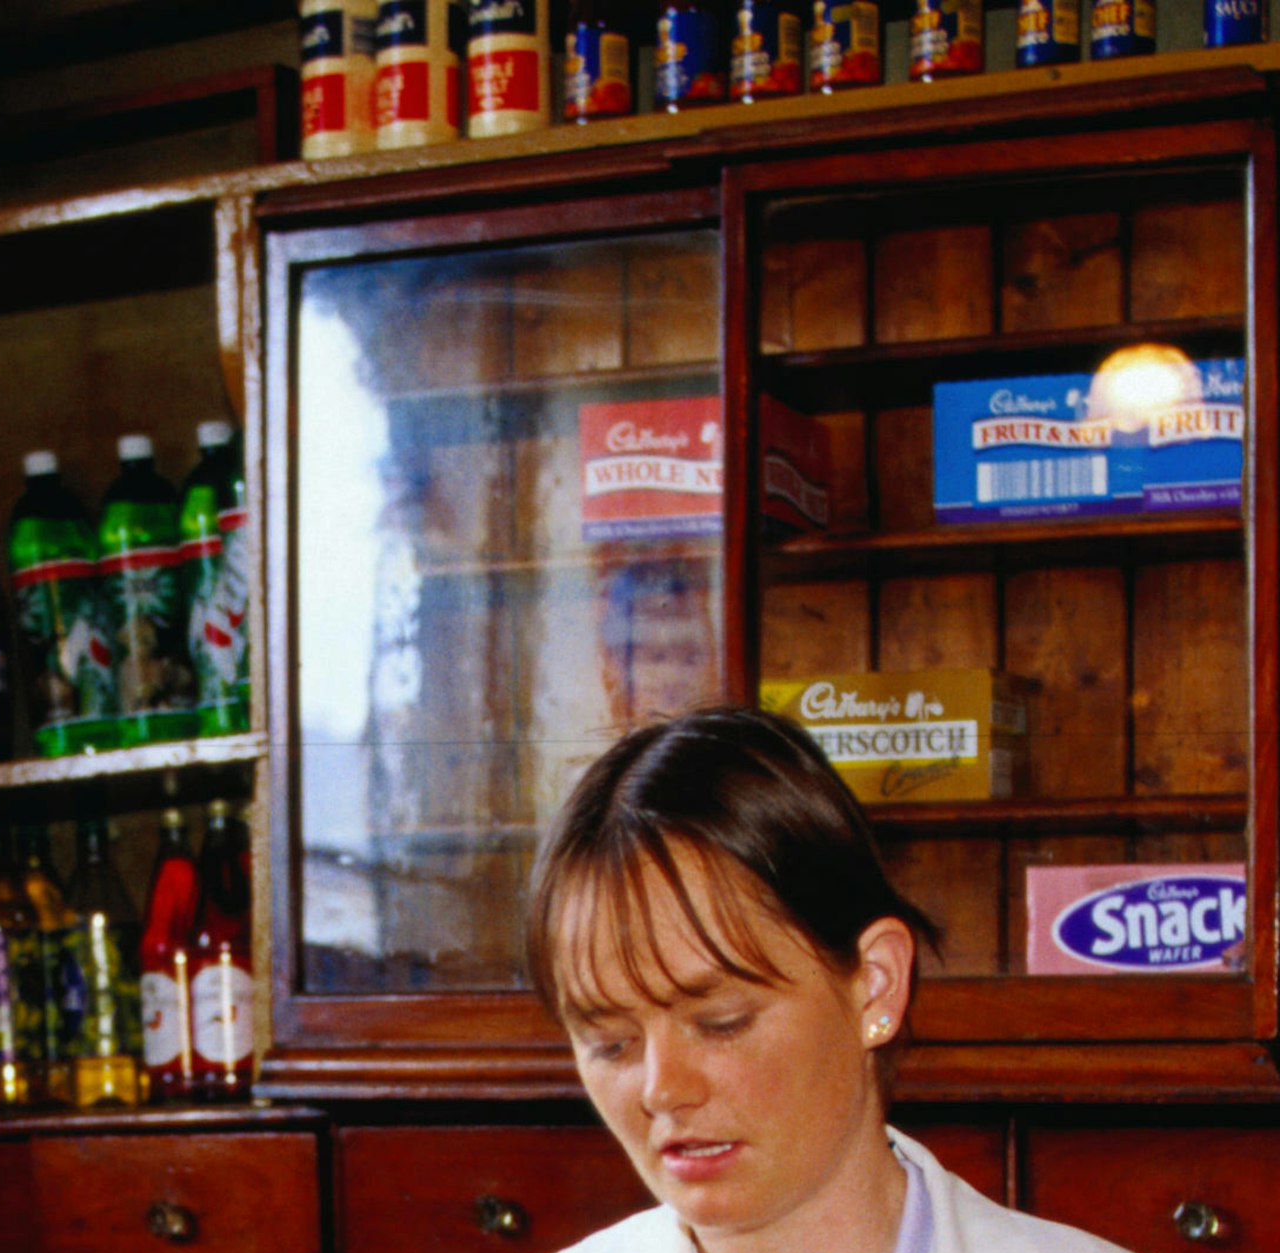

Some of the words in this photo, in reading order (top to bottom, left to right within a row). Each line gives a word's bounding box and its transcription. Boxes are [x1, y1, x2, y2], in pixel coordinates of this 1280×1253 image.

[981, 422, 1043, 445] FRUIT
[1047, 425, 1061, 442] &
[1067, 424, 1108, 445] NUT
[593, 460, 686, 485] WHOLE
[800, 680, 899, 721] Cadbury's
[823, 727, 966, 757] ERSCOTCH
[1090, 886, 1247, 957] Snack
[1149, 946, 1202, 964] WAFER
